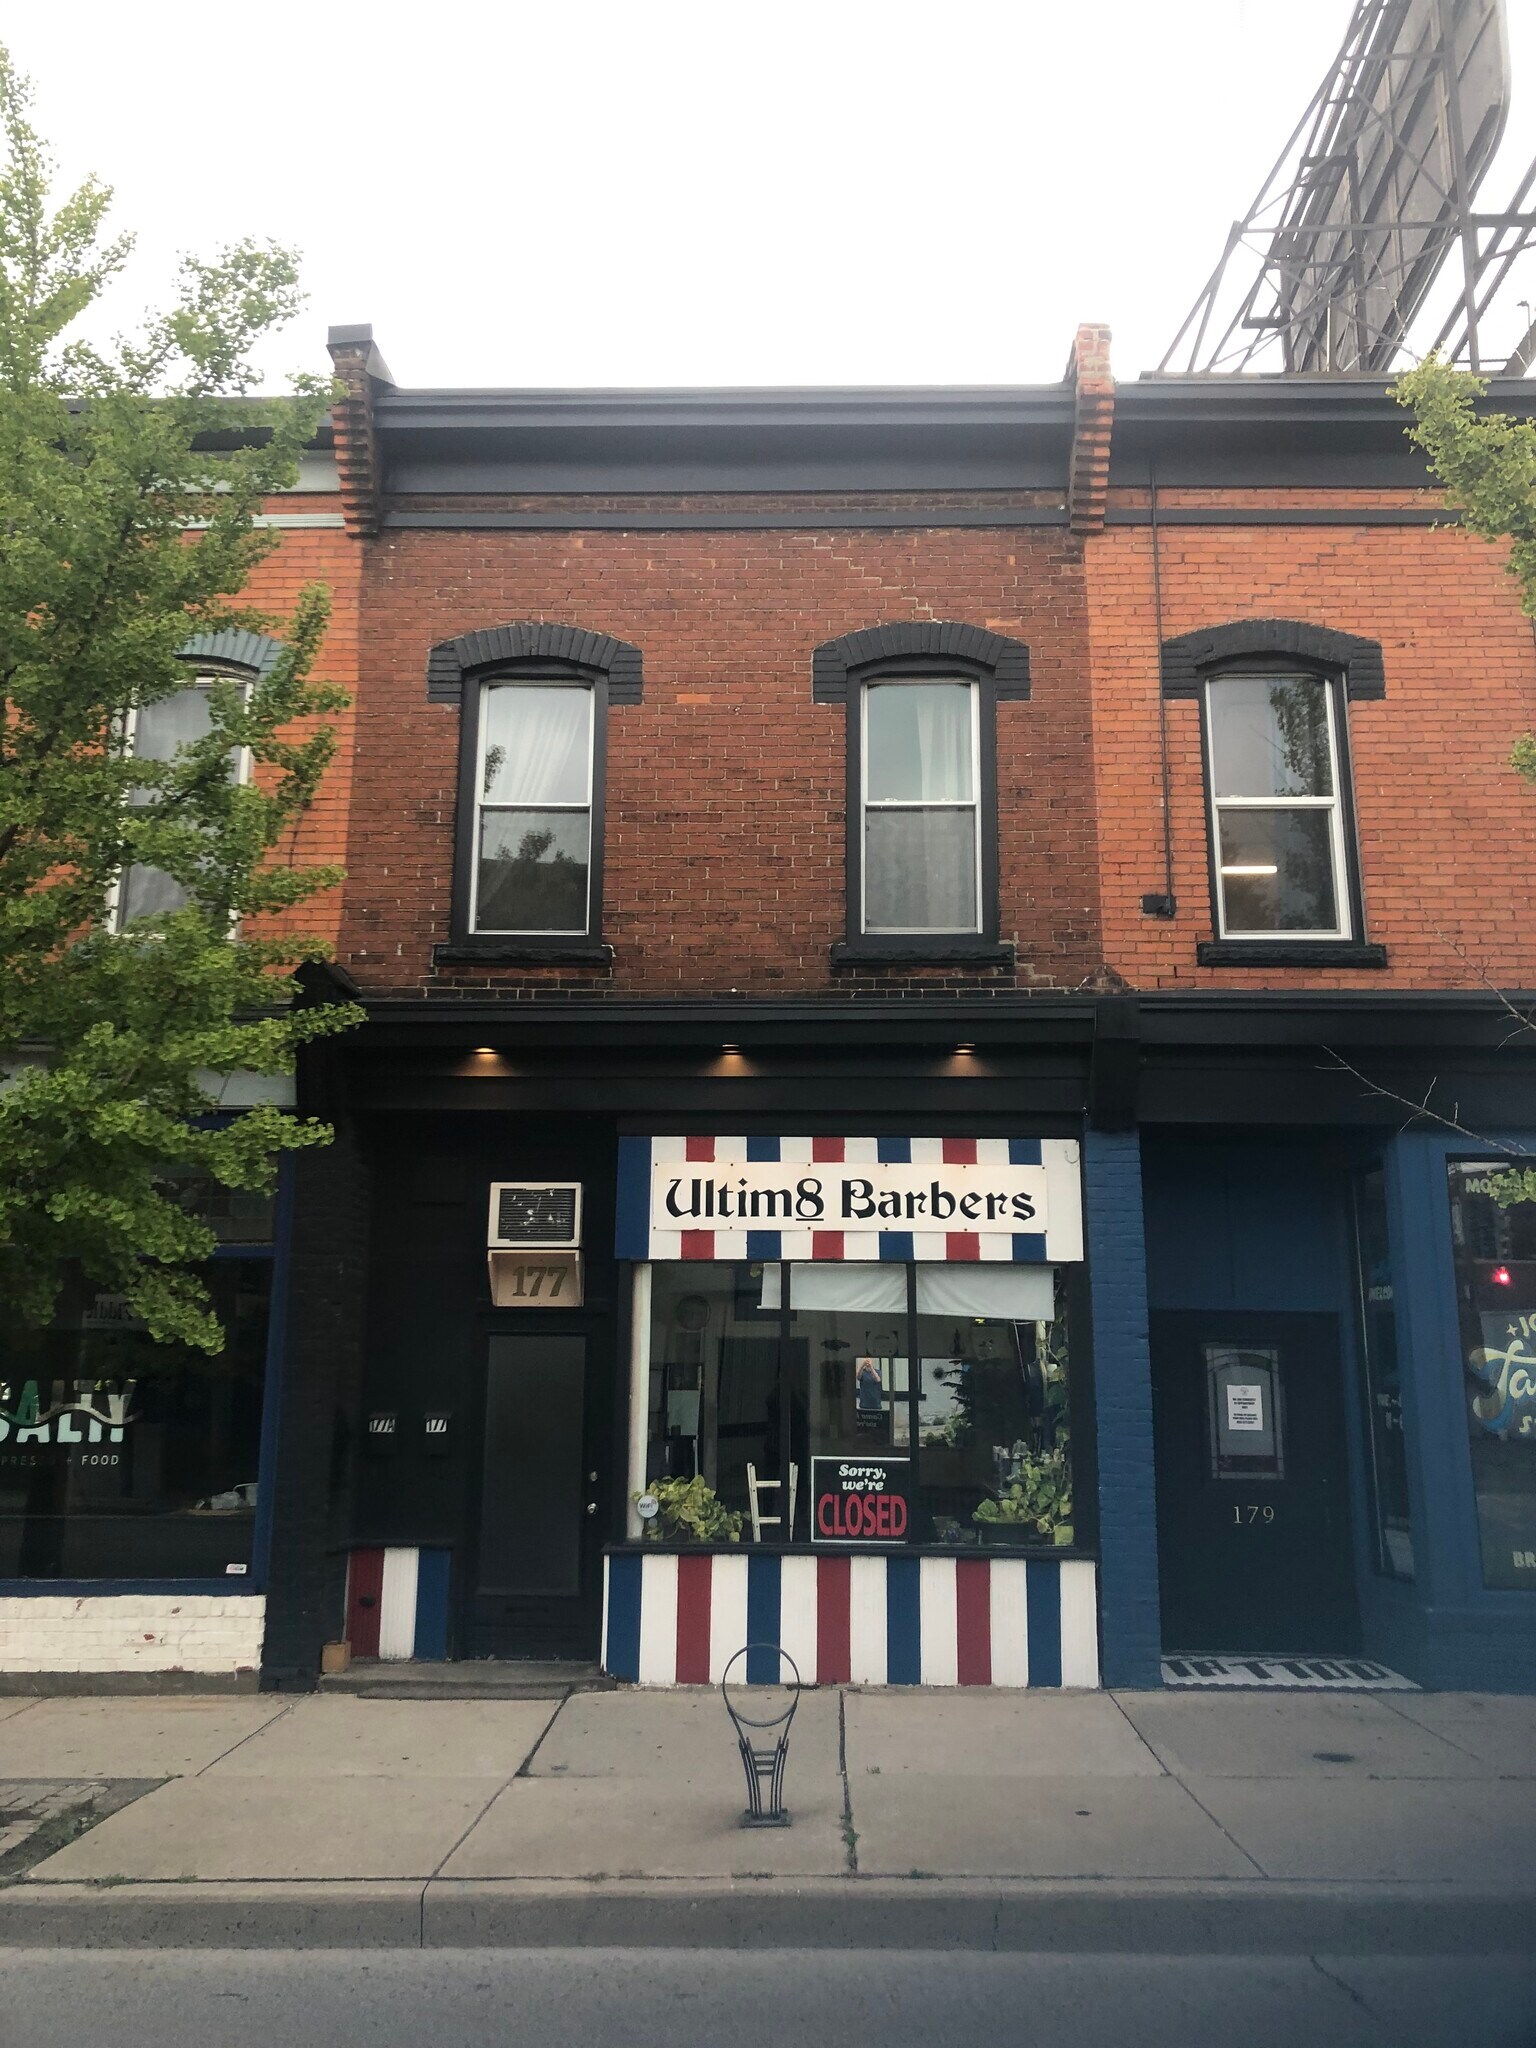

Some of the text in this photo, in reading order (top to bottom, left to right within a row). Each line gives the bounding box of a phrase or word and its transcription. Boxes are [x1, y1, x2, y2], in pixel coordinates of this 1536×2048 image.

[665, 1178, 1037, 1222] Ultim8 Barbers
[512, 1265, 568, 1298] 177
[81, 1454, 119, 1466] FOOD
[838, 1463, 887, 1481] Sorry,
[841, 1478, 884, 1492] we're
[817, 1493, 908, 1538] CLOSED
[1232, 1504, 1275, 1525] 179
[1160, 1657, 1388, 1681] TATTOO
